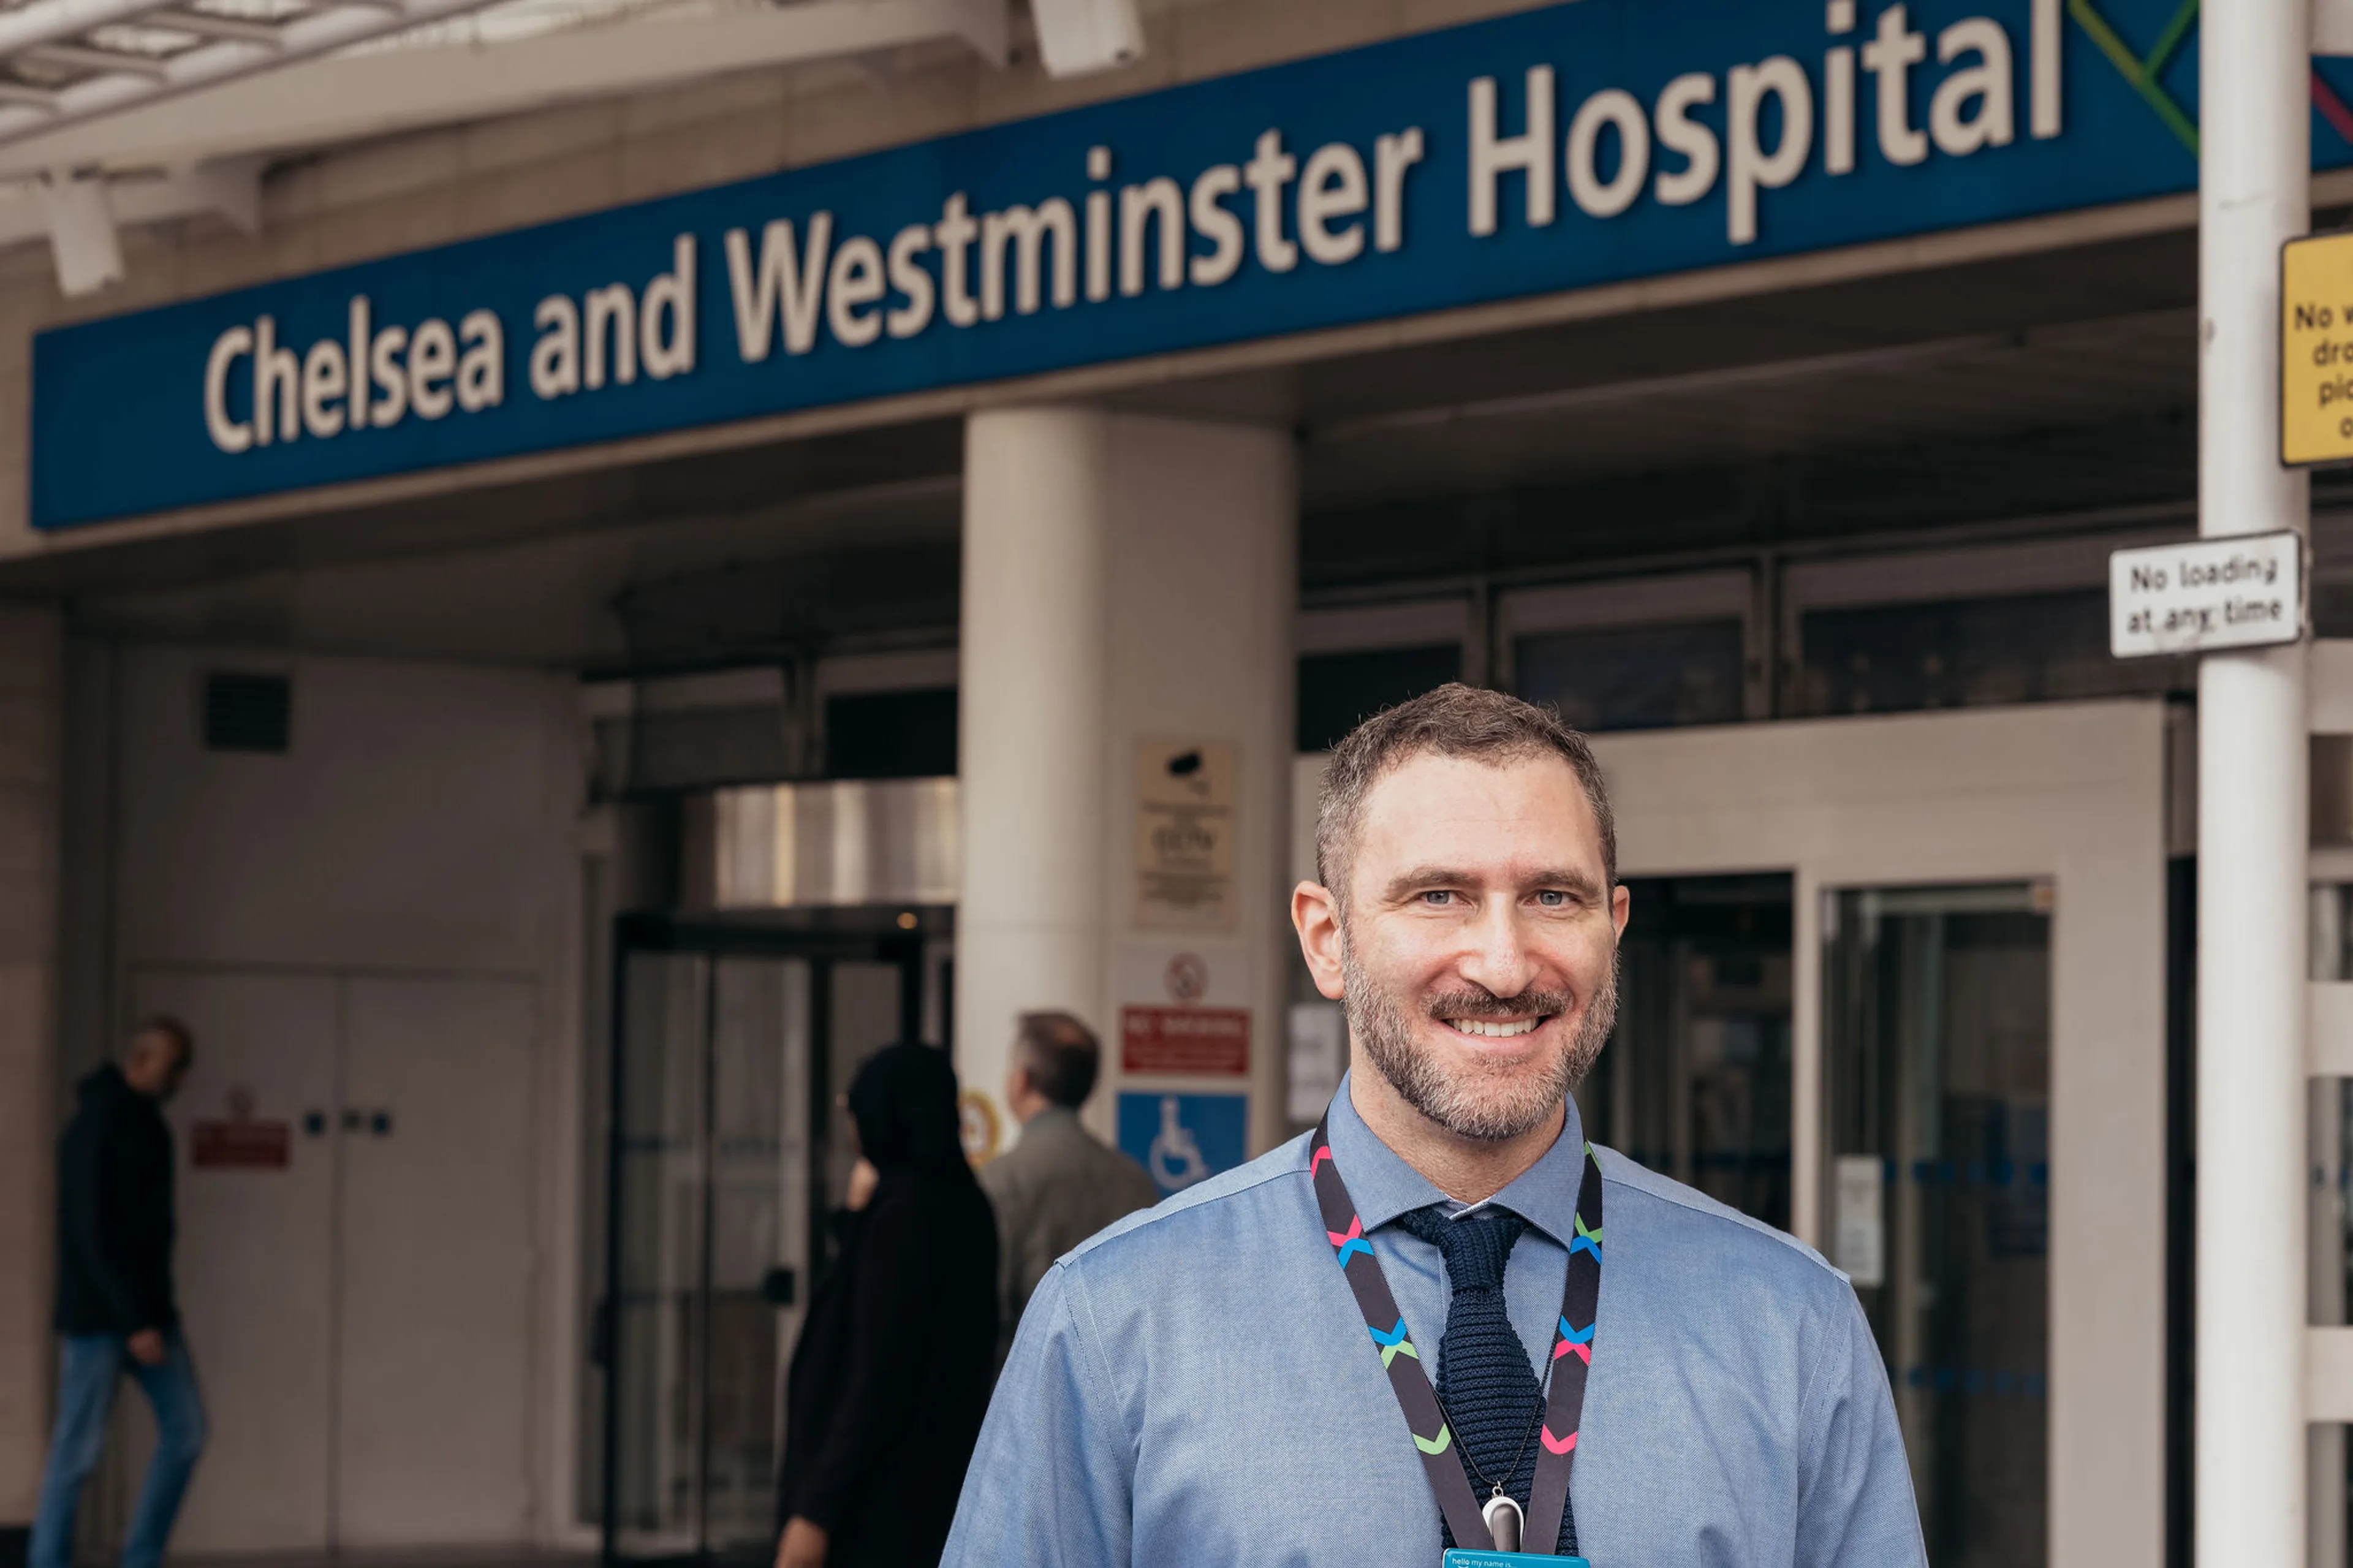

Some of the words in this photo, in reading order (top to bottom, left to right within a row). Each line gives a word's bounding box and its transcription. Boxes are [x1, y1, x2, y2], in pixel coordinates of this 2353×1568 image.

[205, 294, 505, 453] Chelsea
[529, 232, 697, 400] and
[724, 126, 1424, 363] Westminster
[1468, 0, 2063, 245] Hospital
[2294, 301, 2335, 332] No
[2129, 563, 2167, 592] No
[2180, 555, 2278, 588] loading
[2127, 607, 2153, 634] at
[2165, 607, 2215, 634] any
[2224, 597, 2283, 624] time
[1452, 1557, 1470, 1566] hello
